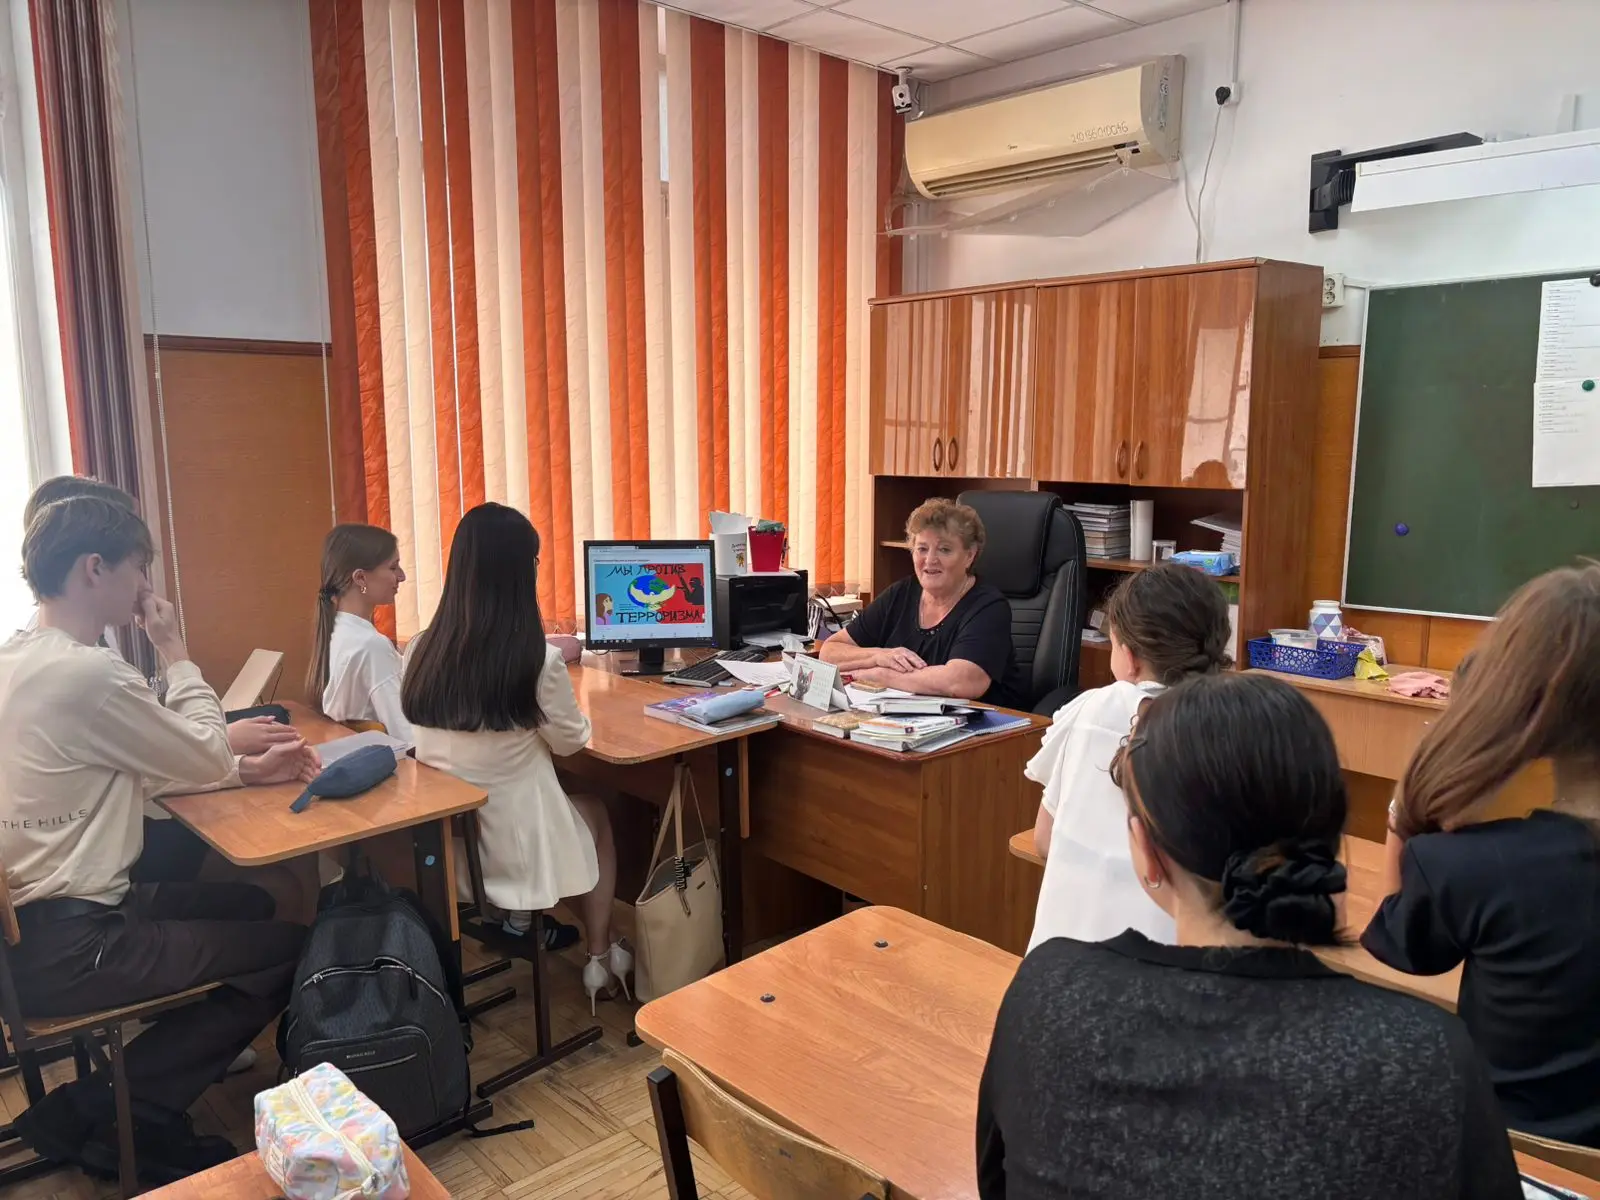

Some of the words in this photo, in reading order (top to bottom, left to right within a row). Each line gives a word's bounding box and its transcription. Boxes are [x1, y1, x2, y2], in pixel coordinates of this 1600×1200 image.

[606, 565, 633, 578] МЫ
[637, 564, 687, 575] ПРОТИВ
[616, 612, 700, 623] ТЕРРОРИЗМА
[1, 819, 32, 830] THE
[38, 808, 89, 828] HILLS
